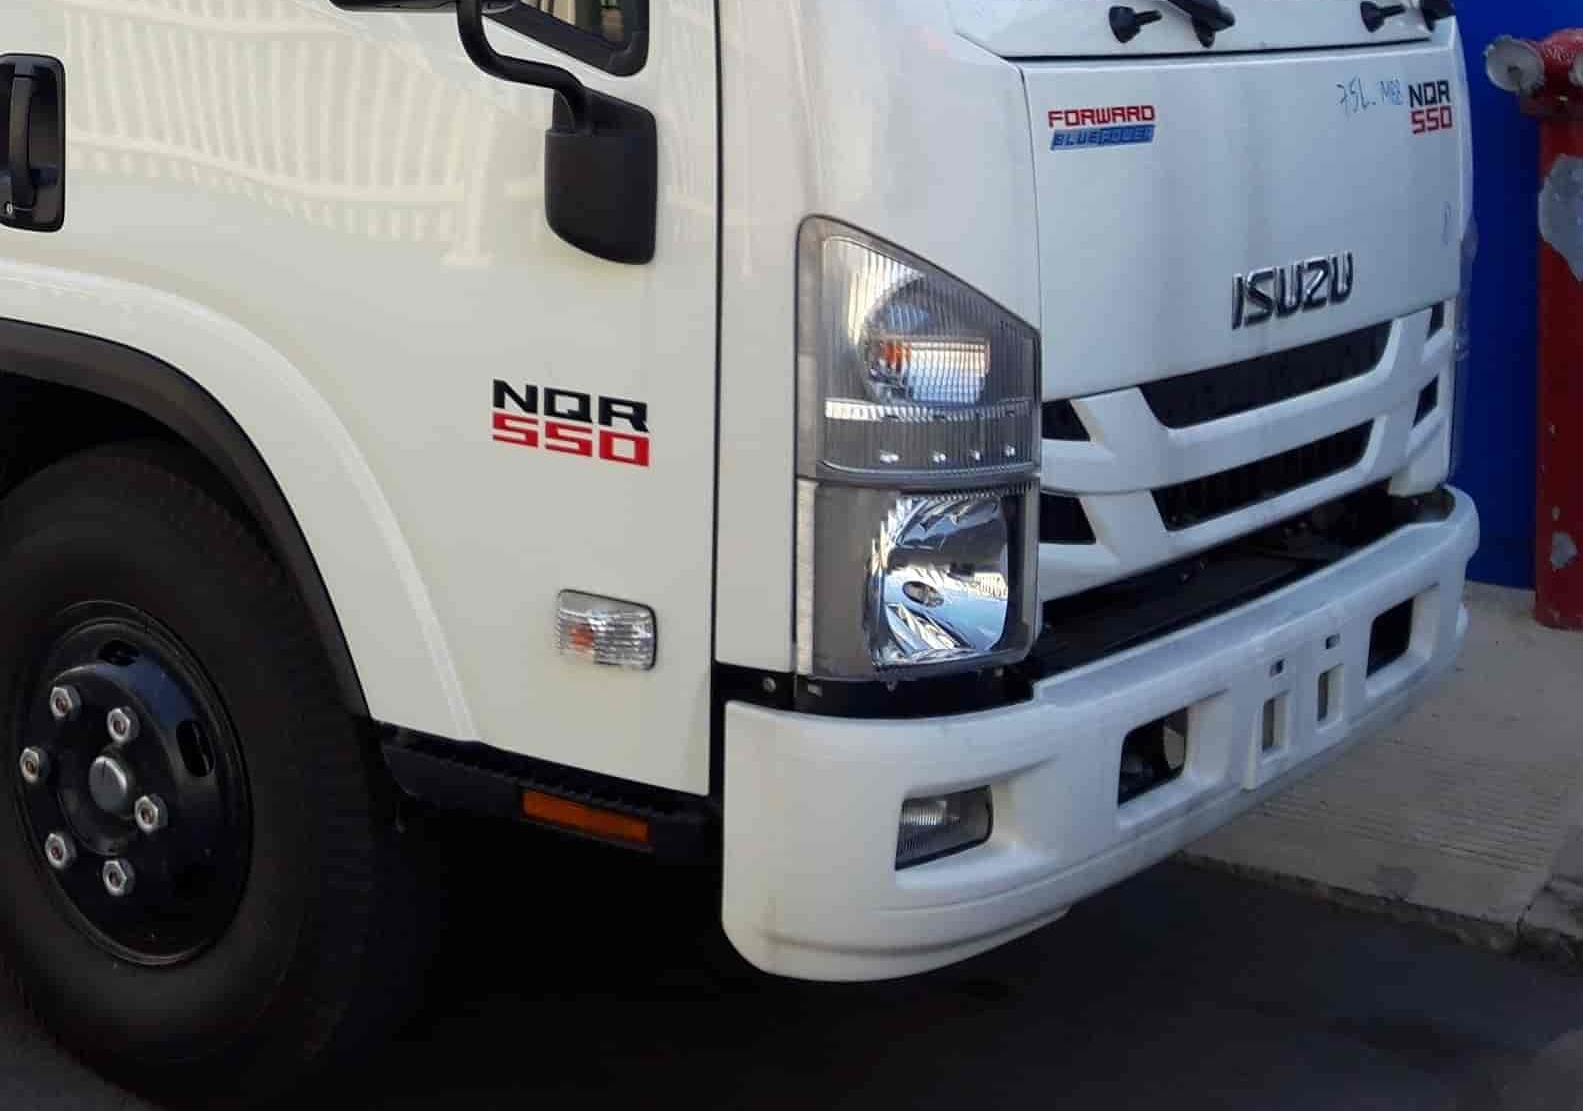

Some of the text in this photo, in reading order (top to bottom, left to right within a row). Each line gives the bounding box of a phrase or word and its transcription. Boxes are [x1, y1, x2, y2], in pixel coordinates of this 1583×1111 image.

[1408, 79, 1451, 108] NQR
[1048, 105, 1156, 128] FORWARD
[1410, 105, 1453, 135] 550
[1231, 252, 1354, 330] ISUZU
[493, 378, 649, 433] NQR
[492, 411, 650, 467] 550
